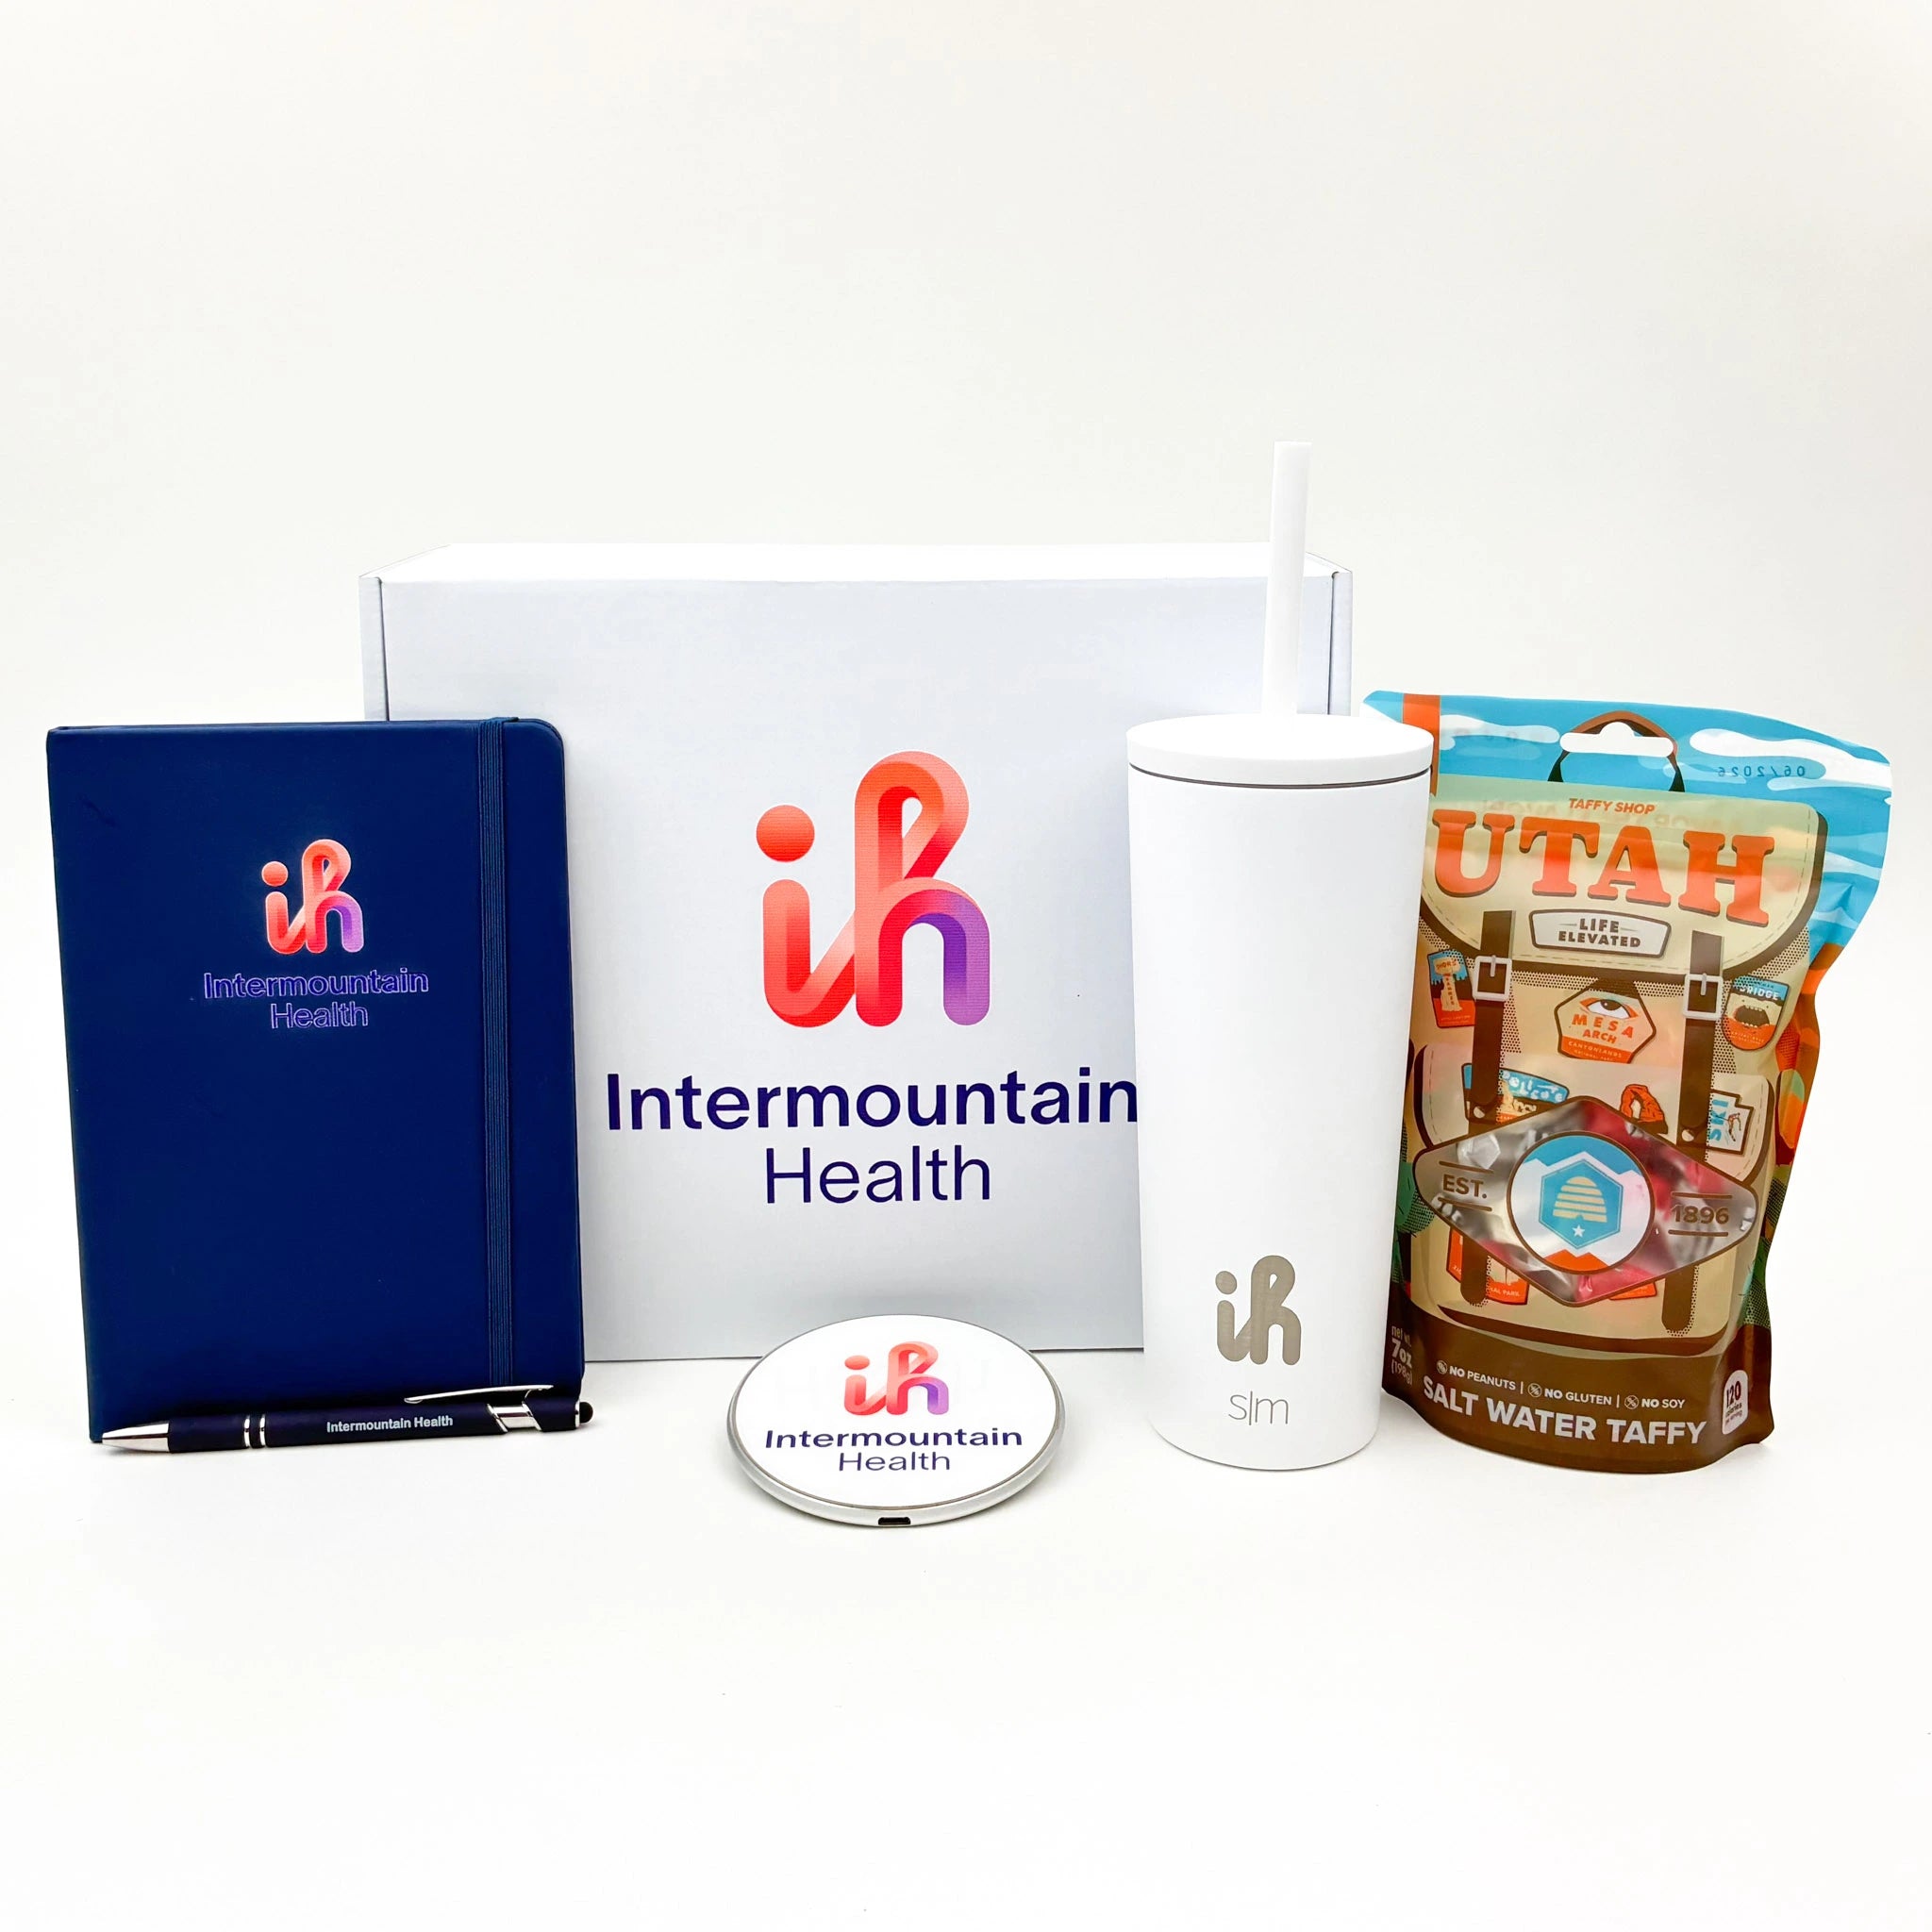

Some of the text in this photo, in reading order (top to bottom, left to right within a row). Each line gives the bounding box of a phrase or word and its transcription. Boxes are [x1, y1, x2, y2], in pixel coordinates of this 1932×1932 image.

[1568, 798, 1612, 811] TAFFY
[1614, 802, 1656, 814] SHOP
[1432, 809, 1774, 927] UTAH
[1579, 918, 1620, 933] LIFE
[1558, 930, 1641, 948] ELEVATED
[203, 966, 430, 1000] Intermountain
[270, 1001, 369, 1029] Health
[1571, 1013, 1634, 1038] MESA
[1582, 1029, 1617, 1043] ARCH
[607, 1067, 1138, 1130] Intermountain
[1708, 1099, 1729, 1141] SKI
[766, 1144, 991, 1204] Health
[1442, 1174, 1488, 1199] EST.
[1672, 1204, 1730, 1225] 1896
[1391, 1338, 1412, 1369] 7oz
[1449, 1366, 1517, 1391] NO PEANUTS
[1544, 1388, 1612, 1406] NO GLUTEN
[1641, 1398, 1686, 1408] NO SOY
[1726, 1380, 1741, 1408] 120
[1423, 1375, 1707, 1445] SALT WATER TAFFY
[326, 1415, 454, 1433] Intermountain Health
[765, 1427, 1024, 1449] Intermountain
[838, 1451, 951, 1472] Health
